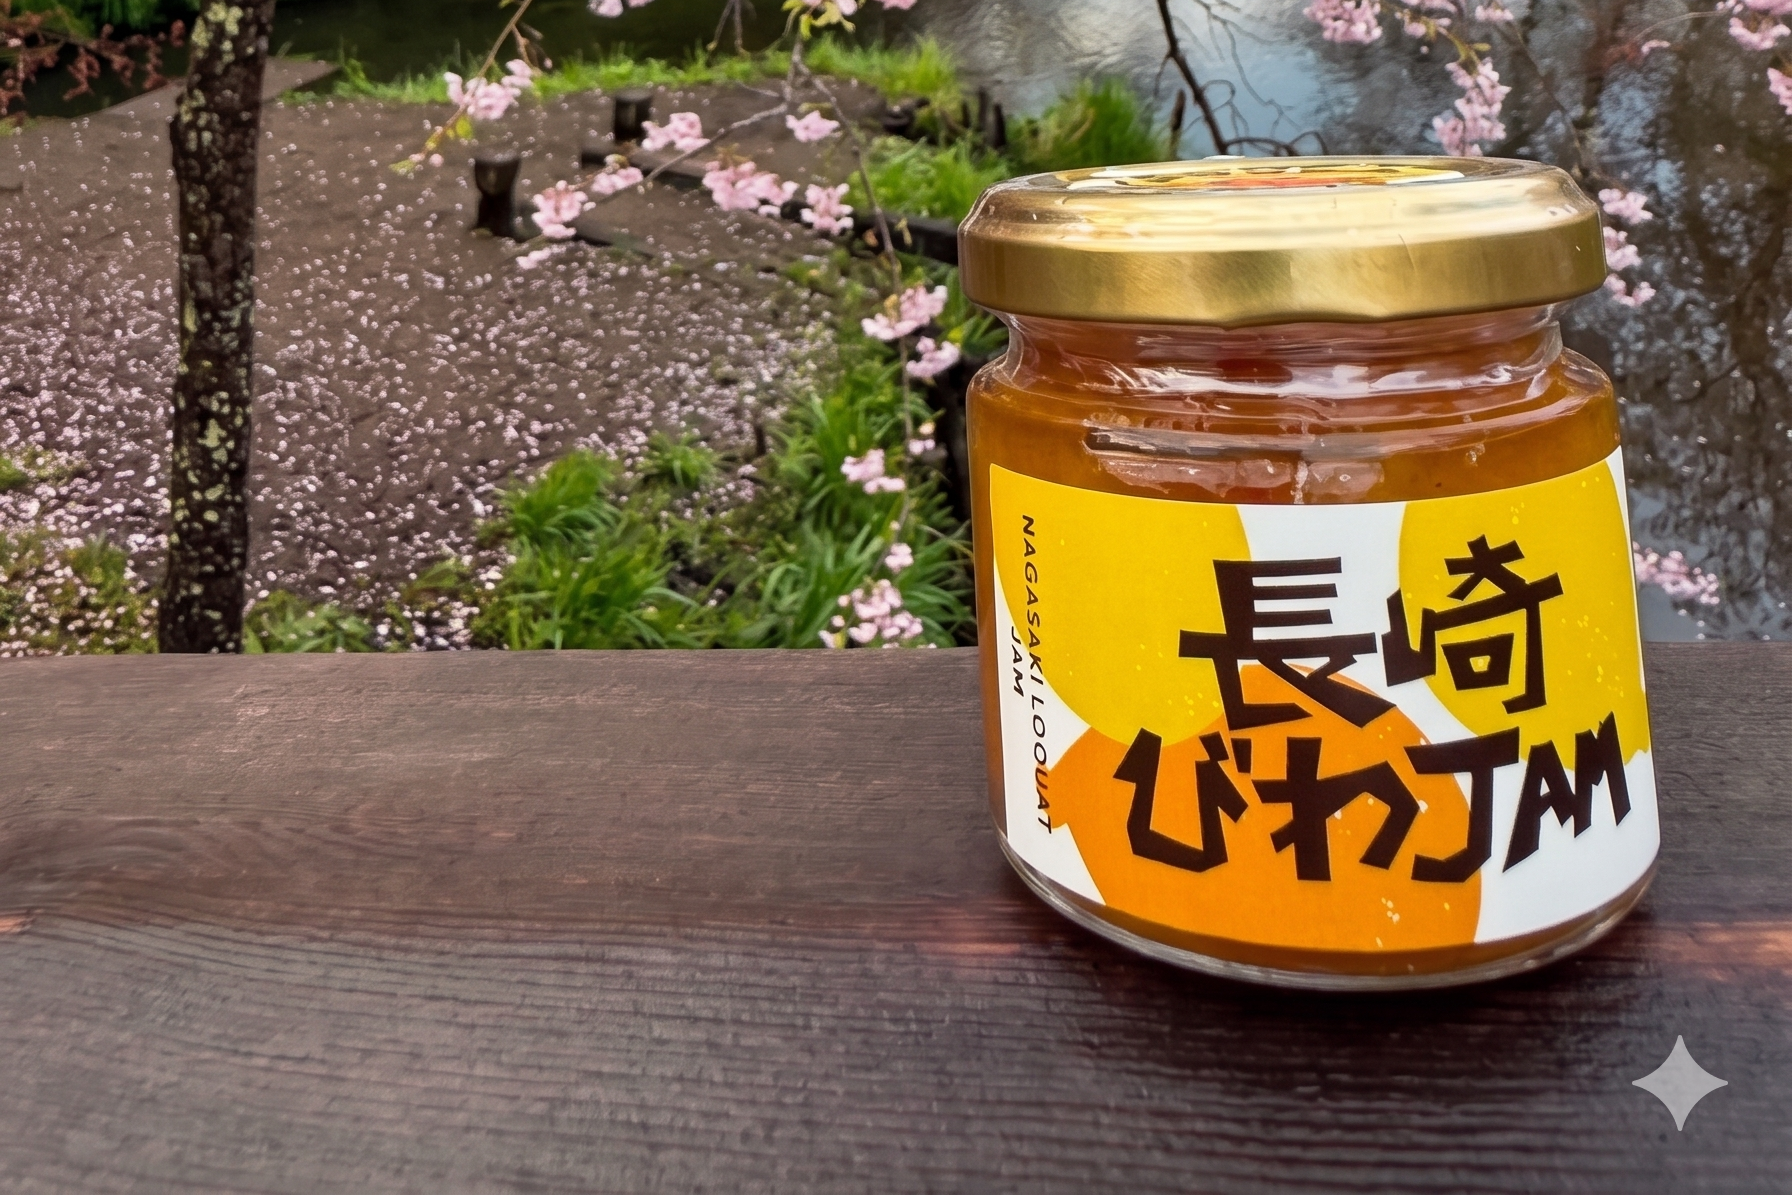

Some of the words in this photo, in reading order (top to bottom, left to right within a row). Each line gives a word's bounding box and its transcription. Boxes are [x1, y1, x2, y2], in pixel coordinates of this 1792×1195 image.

[1011, 626, 1025, 697] JAM
[1022, 514, 1044, 685] NAGASAKI
[1178, 535, 1563, 729] 長崎
